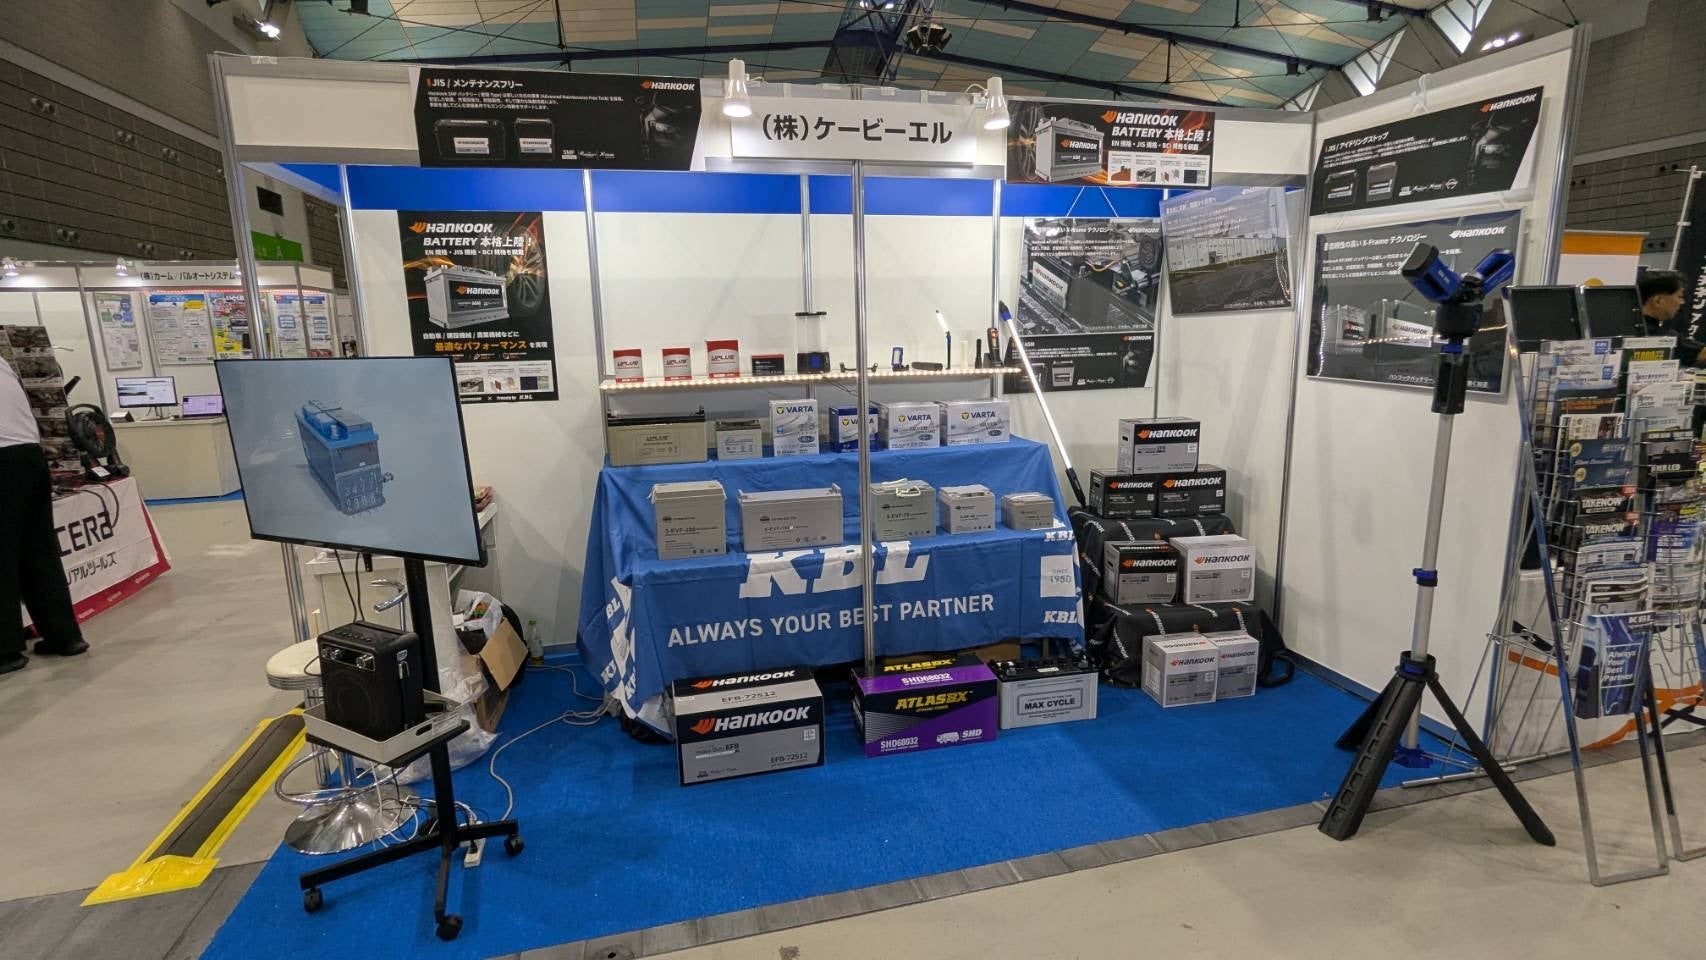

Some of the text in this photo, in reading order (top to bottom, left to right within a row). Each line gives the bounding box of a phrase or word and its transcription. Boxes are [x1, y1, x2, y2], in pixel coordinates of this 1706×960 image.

[431, 79, 446, 88] JIS
[453, 80, 523, 88] メンテナンスフリー
[762, 114, 952, 144] (株)ケービーエル
[1111, 127, 1162, 138] BATTERY
[1340, 132, 1389, 150] アイドリングストップ
[423, 237, 478, 247] BATTERY
[1390, 234, 1427, 245] テクノロジー
[434, 340, 527, 352] 最適なパフォーマンス
[786, 405, 813, 414] VARTA
[971, 411, 996, 419] VARTA
[907, 414, 932, 422] VARTA
[738, 541, 930, 599] KBL
[1050, 574, 1072, 583] 1950
[667, 594, 994, 648] ALWAYS YOUR BEST PARTNER
[1043, 610, 1078, 623] KBL
[884, 658, 954, 672] ATLASBX
[901, 673, 951, 684] SHD68032
[895, 691, 969, 711] ATLASBX
[1025, 697, 1076, 711] MAX CYCLE
[962, 729, 983, 738] SHD
[880, 736, 919, 749] SHD68032
